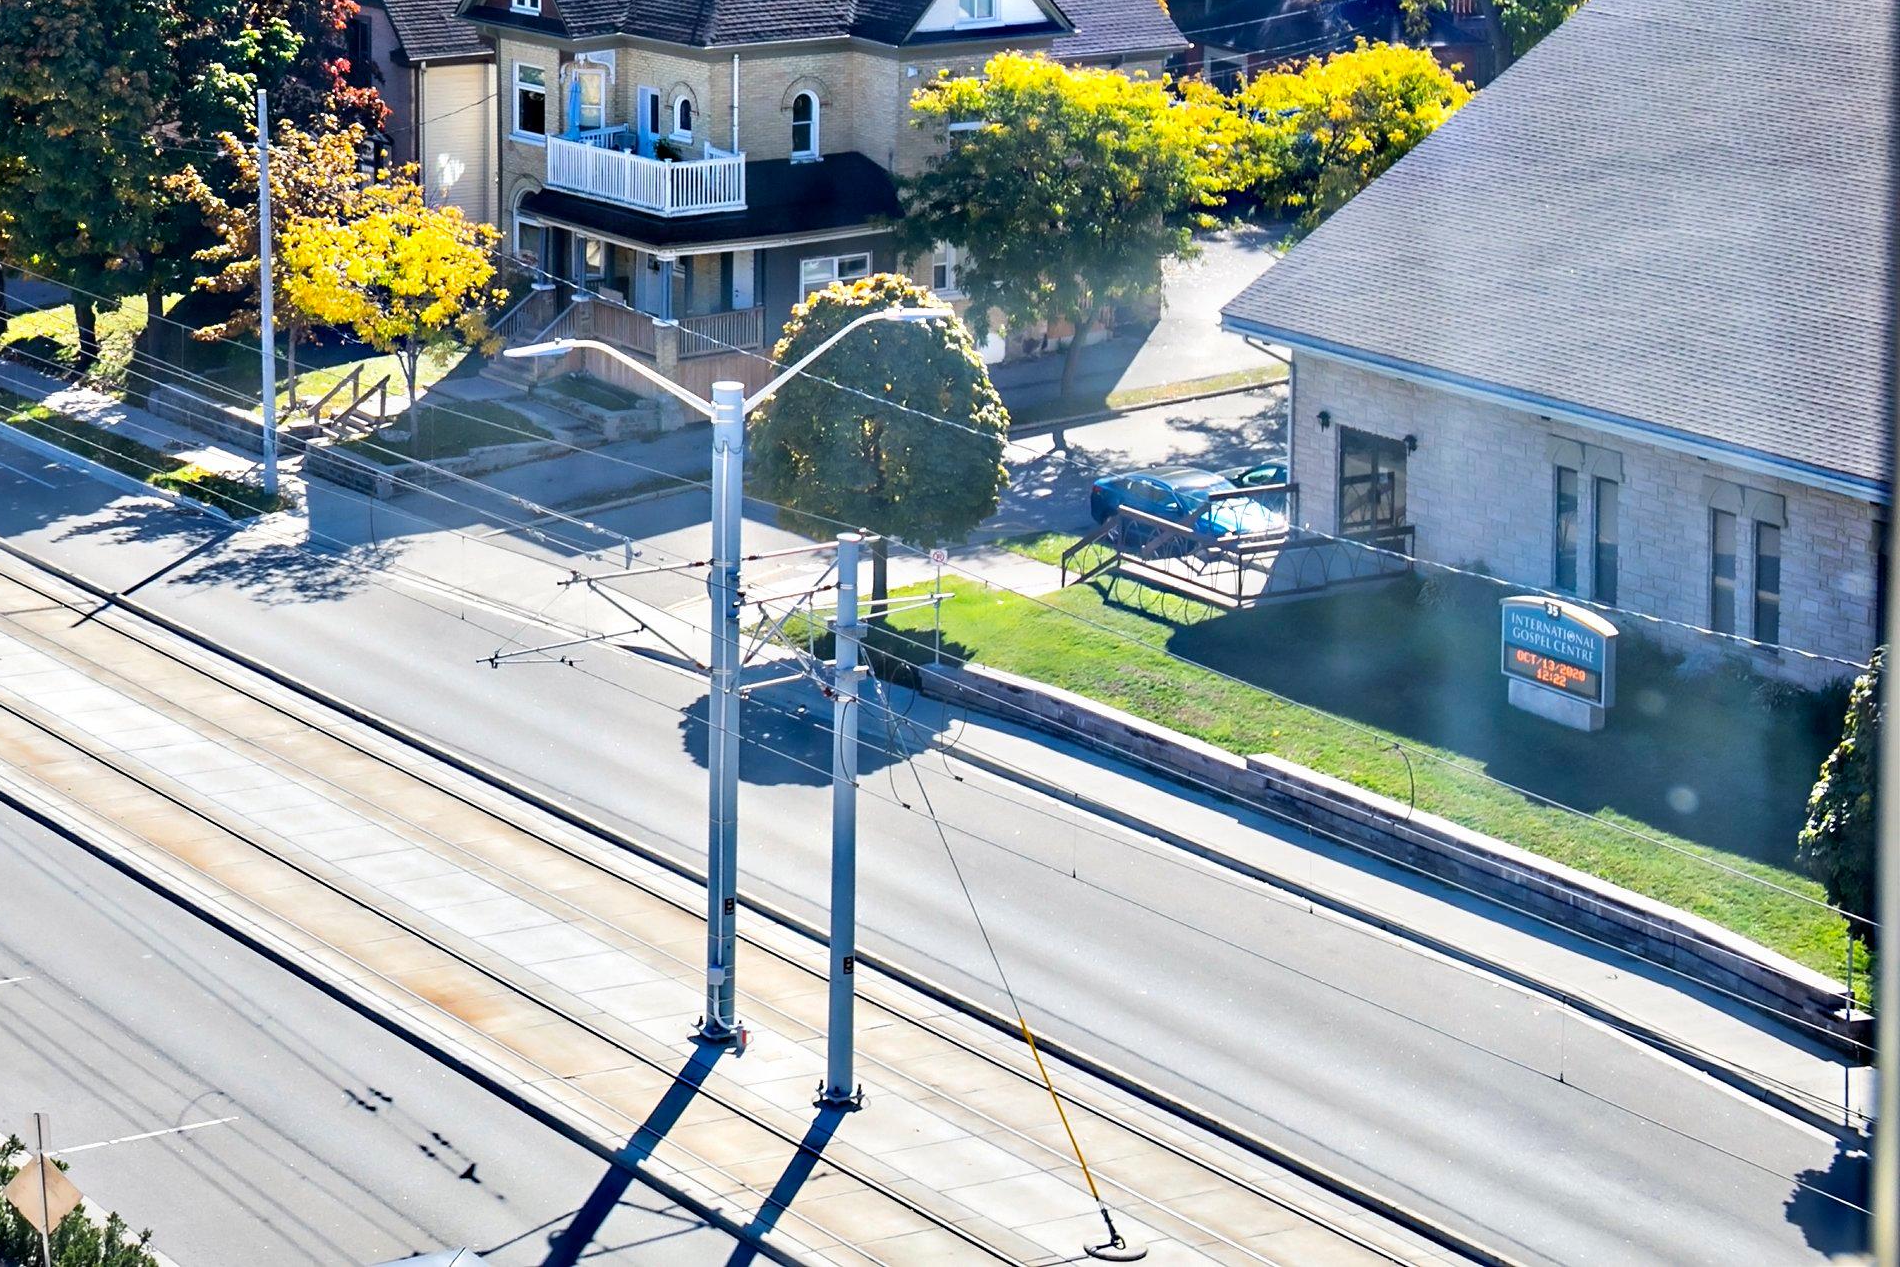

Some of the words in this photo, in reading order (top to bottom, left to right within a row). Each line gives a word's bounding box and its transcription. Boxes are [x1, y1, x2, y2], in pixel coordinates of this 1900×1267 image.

[1546, 603, 1560, 617] 35
[1511, 612, 1596, 650] INTERNATIONAL
[1512, 626, 1552, 650] GOSPEL
[1553, 639, 1594, 663] CENTRE
[1516, 649, 1586, 682] OCT/13/2020
[1536, 668, 1567, 688] 12:22
